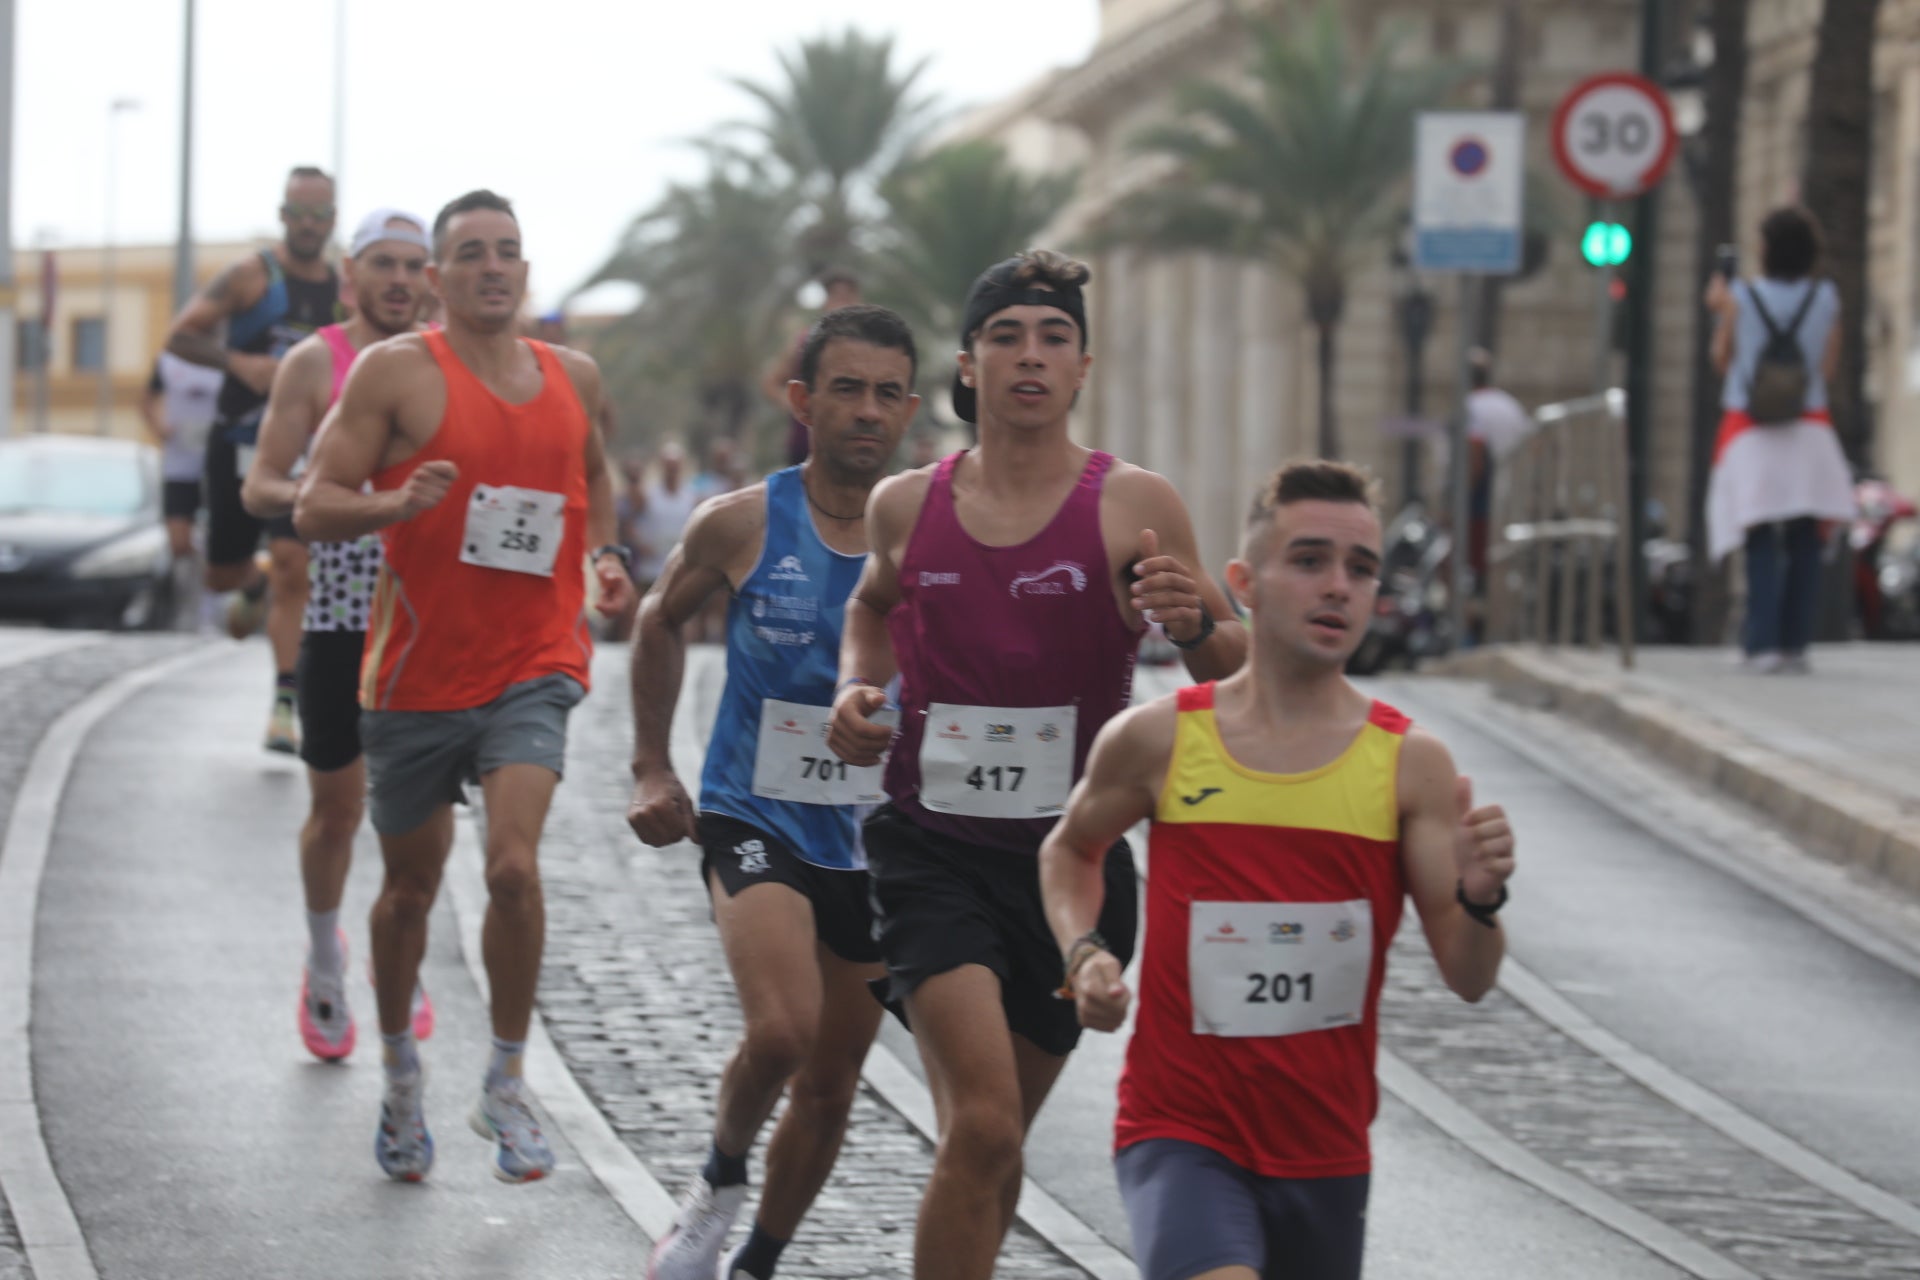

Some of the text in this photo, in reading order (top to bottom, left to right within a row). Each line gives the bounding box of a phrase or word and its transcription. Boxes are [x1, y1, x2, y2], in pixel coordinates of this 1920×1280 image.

[1581, 112, 1649, 154] 30
[500, 530, 540, 553] 258
[801, 757, 847, 781] 701
[966, 765, 1025, 792] 417
[1246, 972, 1312, 1003] 201
